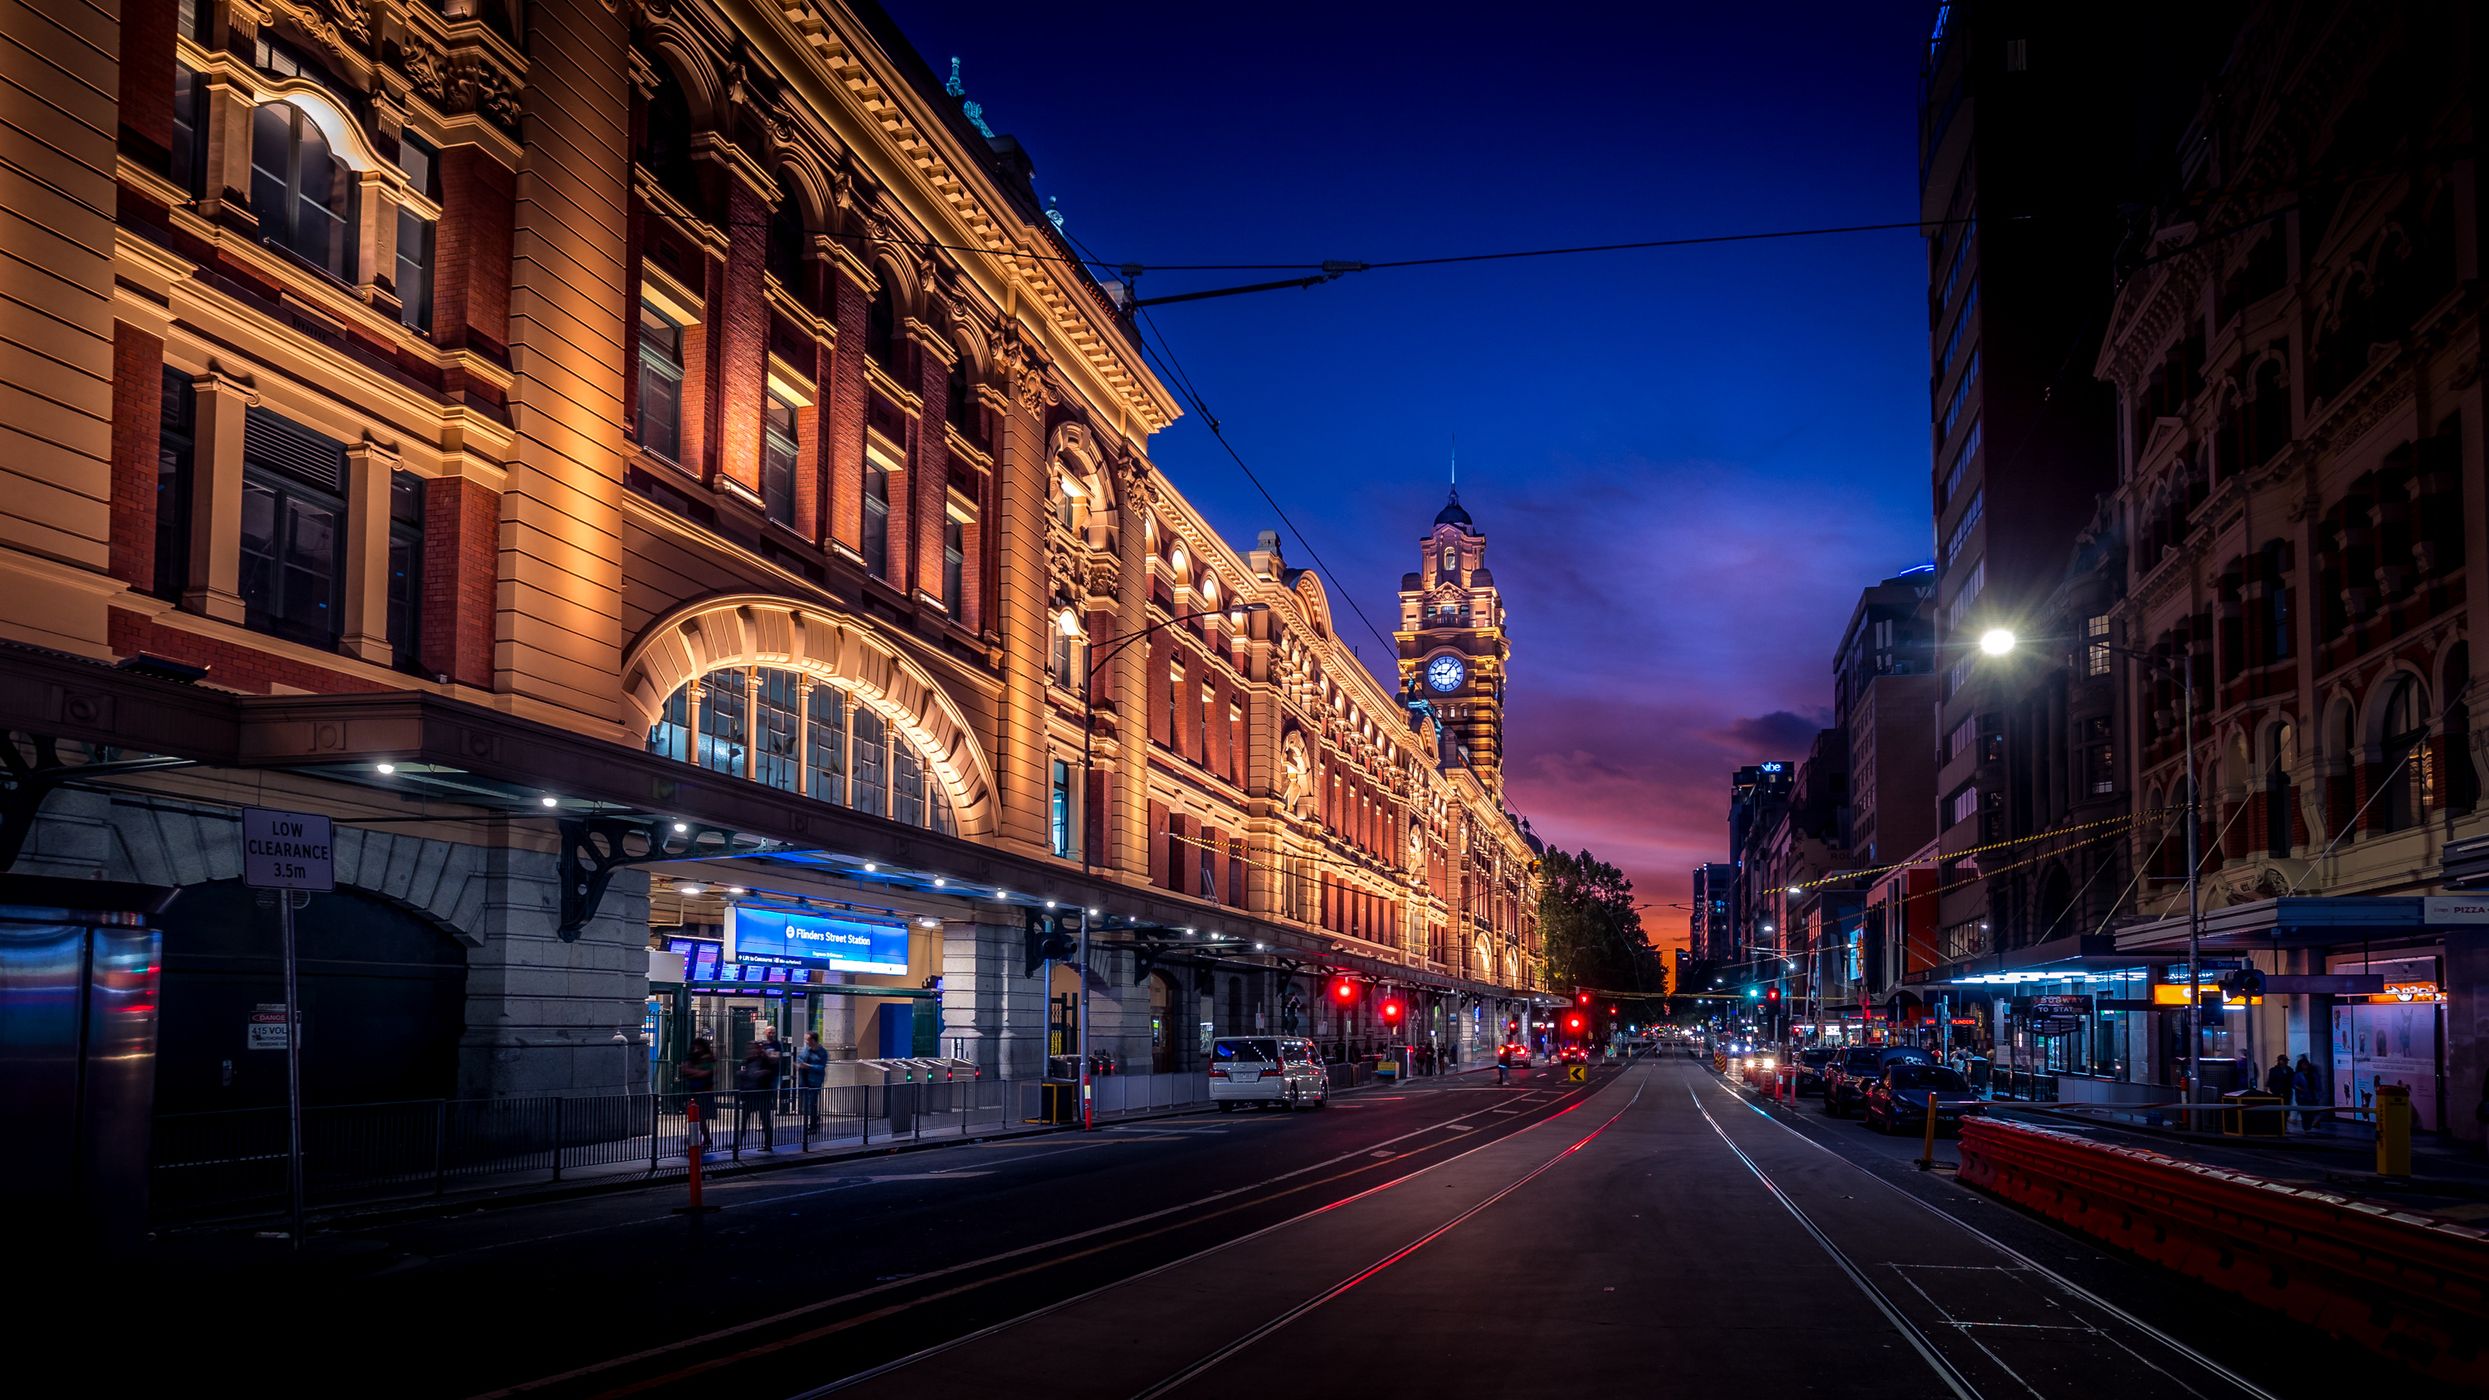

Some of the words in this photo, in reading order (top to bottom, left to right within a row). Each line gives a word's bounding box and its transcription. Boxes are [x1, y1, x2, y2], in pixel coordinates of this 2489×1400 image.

[1761, 761, 1782, 772] vibe
[272, 821, 303, 838] LOW
[248, 839, 329, 860] CLEARANCE
[274, 862, 306, 879] 3.5m
[2454, 906, 2485, 914] PIZZA
[796, 928, 825, 941] Flinders
[825, 931, 847, 943] Street
[848, 934, 871, 946] Station
[2040, 995, 2085, 1004] SUBWAY
